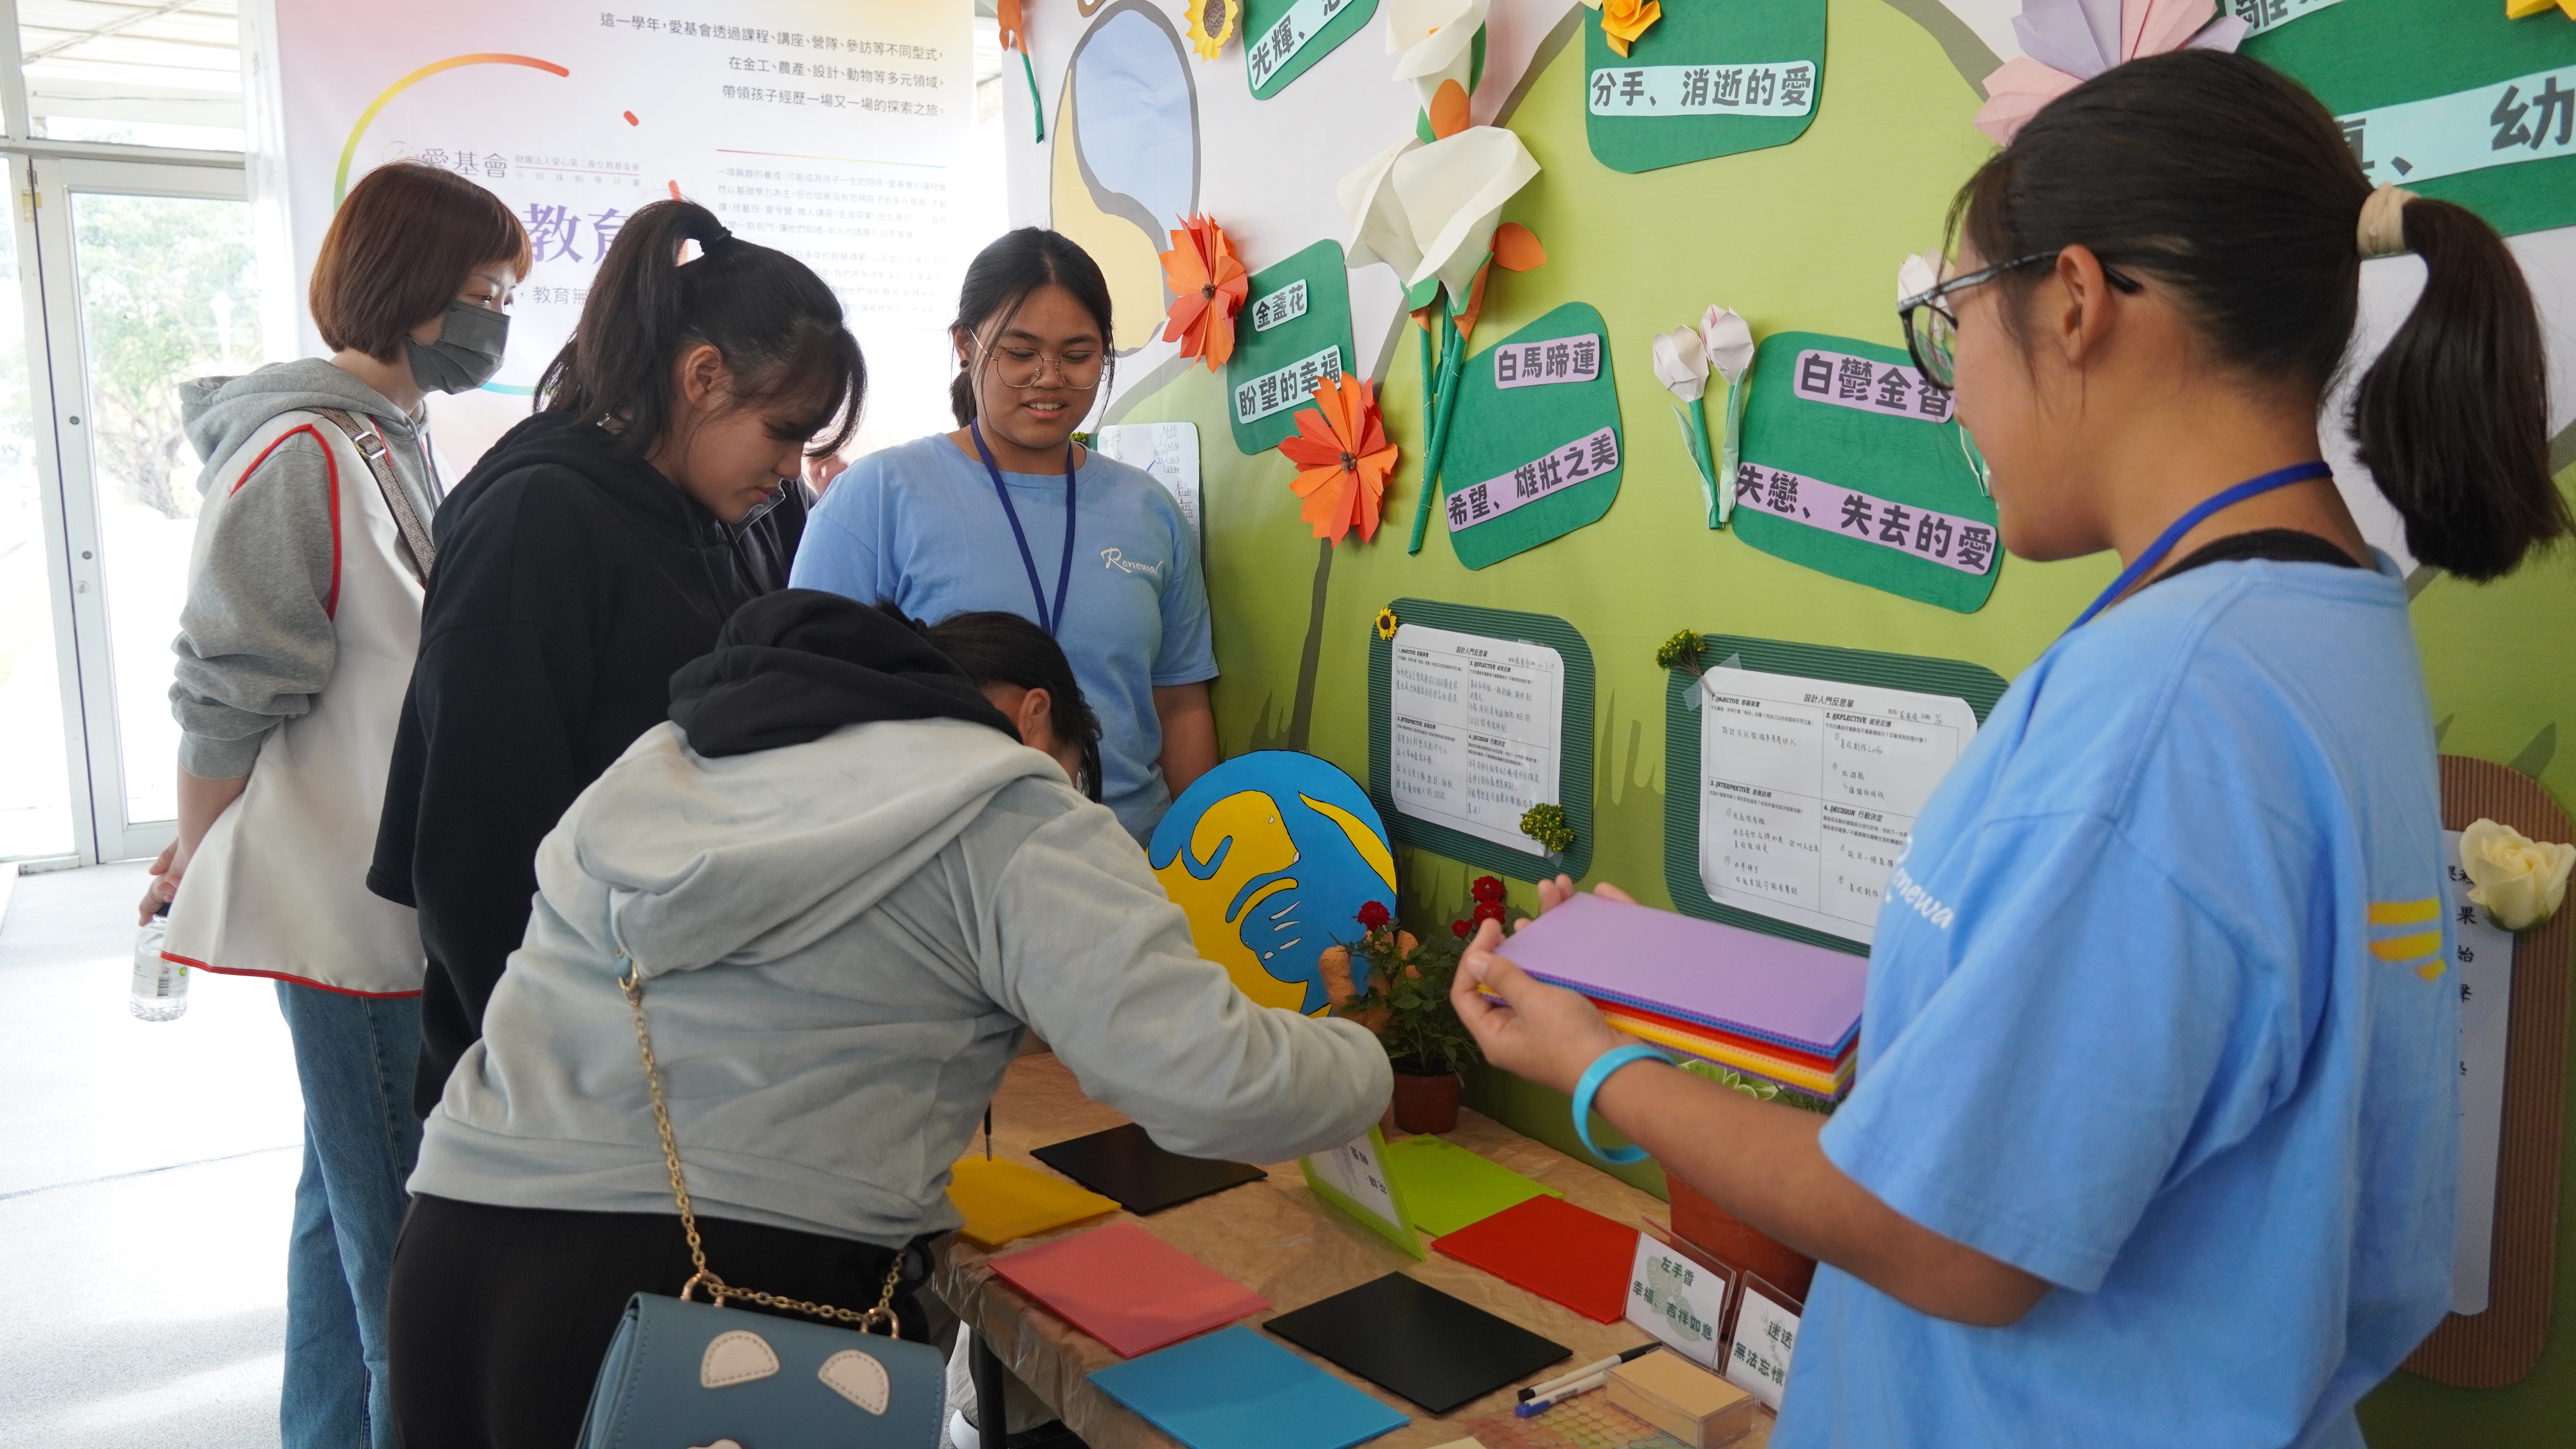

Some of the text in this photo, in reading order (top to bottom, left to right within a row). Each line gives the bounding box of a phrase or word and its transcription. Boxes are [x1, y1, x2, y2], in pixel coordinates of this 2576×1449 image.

[1252, 0, 1340, 85] 光輝、
[723, 85, 945, 118] 帶領孩子經歷一場又一場的探索之旅。
[1592, 66, 1811, 106] 分手、消逝的愛
[1256, 284, 1305, 329] 金盞花
[1499, 341, 1595, 382] 白馬蹄蓮
[1239, 351, 1341, 417] 盼望的幸福
[1801, 353, 1951, 418] 白鬱金香
[1449, 433, 1616, 525] 希望、雄壯之美
[1737, 465, 1993, 570] 失戀、失去的愛
[1100, 547, 1163, 575] Renewal
[1456, 646, 1488, 657] 設計入門反思單
[1474, 661, 1496, 670] REFLECTIVE
[1804, 693, 1854, 707] 設計入門反思單
[1400, 717, 1422, 726] INTERPRETIVE
[1832, 713, 1867, 724] REFLECTIVE
[1869, 718, 1891, 728] 感受反應
[1490, 738, 1506, 748] 行動決定
[1716, 781, 1750, 793] INTERPRETIVE
[1830, 805, 1856, 816] DECISION
[1858, 810, 1883, 822] 行動決定
[1661, 1255, 1694, 1286] 左手香
[1633, 1280, 1713, 1341] 幸福、吉祥如意
[1768, 1321, 1792, 1349] 迷迭
[1734, 1342, 1784, 1386] 無法忘懷
